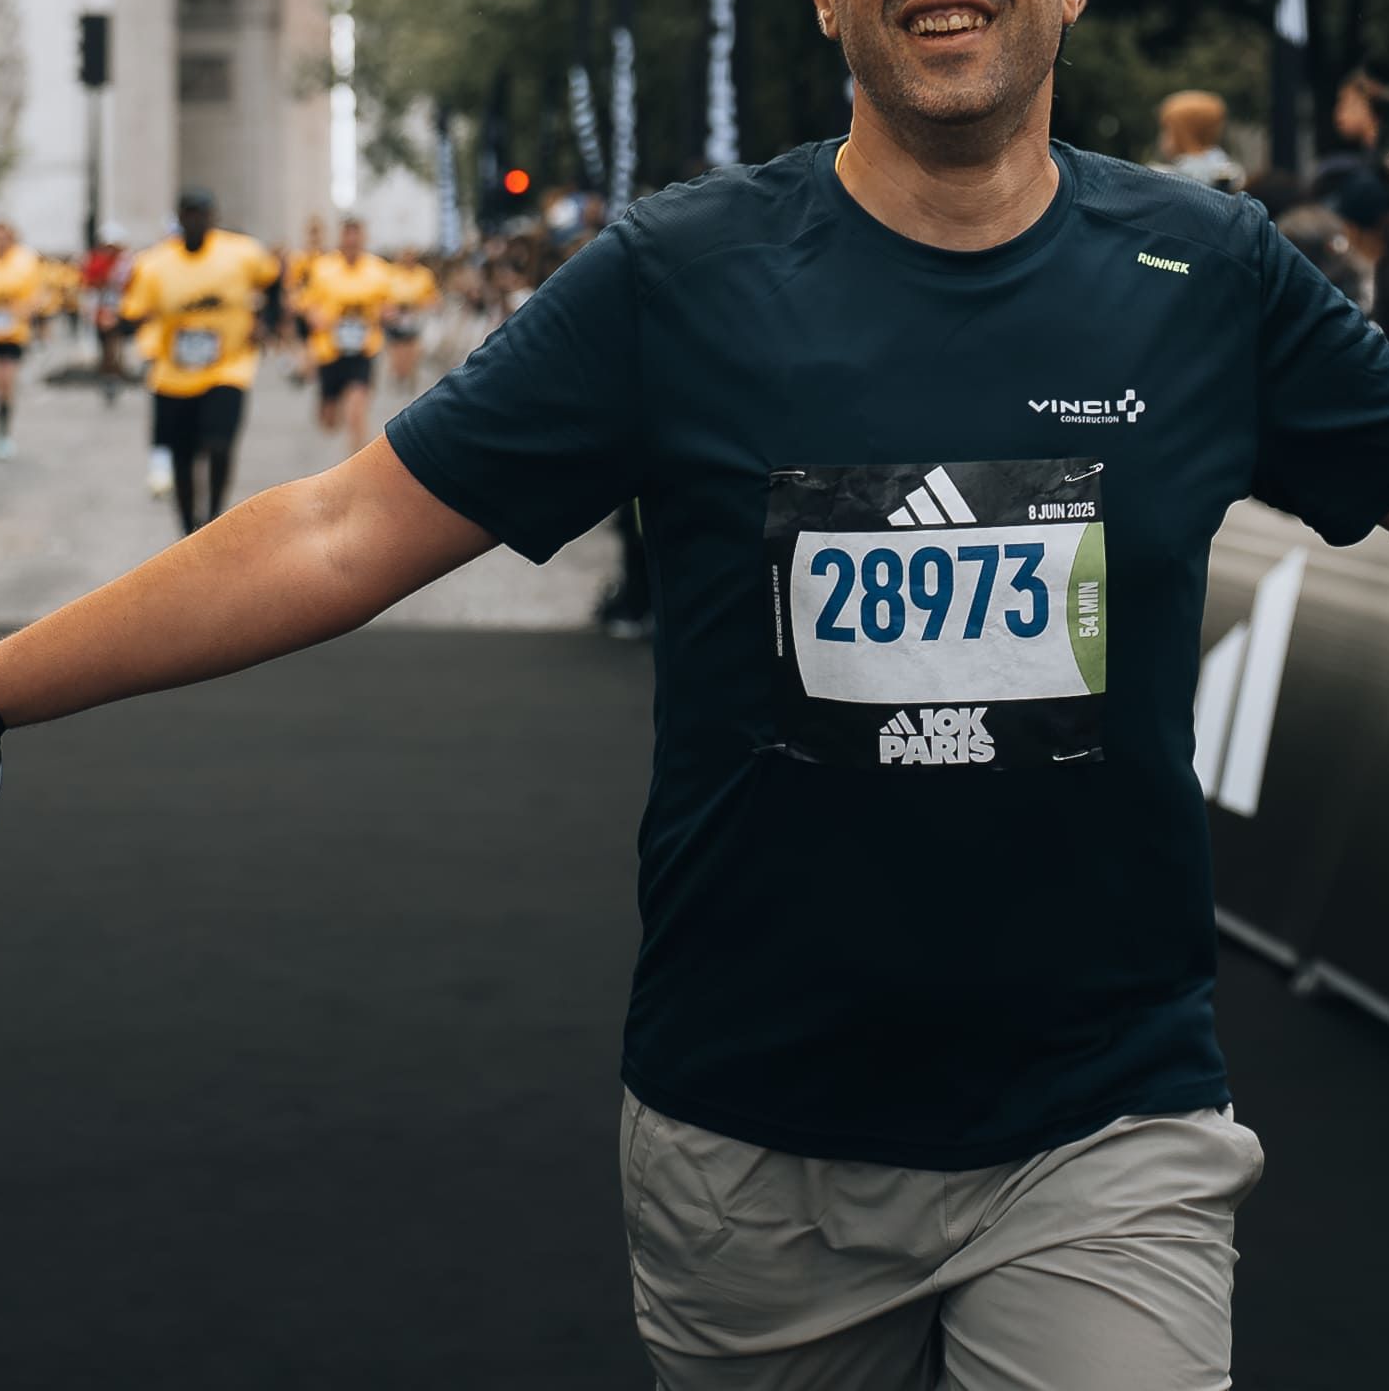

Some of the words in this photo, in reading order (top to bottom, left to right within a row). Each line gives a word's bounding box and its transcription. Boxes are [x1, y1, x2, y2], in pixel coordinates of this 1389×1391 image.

[1137, 251, 1190, 275] RUNNEK
[1027, 399, 1111, 414] VINCI
[1060, 415, 1120, 424] CONSTRUCTION
[1028, 504, 1037, 521] 8
[1038, 503, 1066, 520] JUIN
[1067, 501, 1096, 519] 2025
[810, 542, 1050, 644] 28973
[1078, 581, 1100, 614] MIN
[1078, 615, 1100, 639] 54
[919, 707, 988, 736] 10K
[879, 733, 996, 765] PARIS
